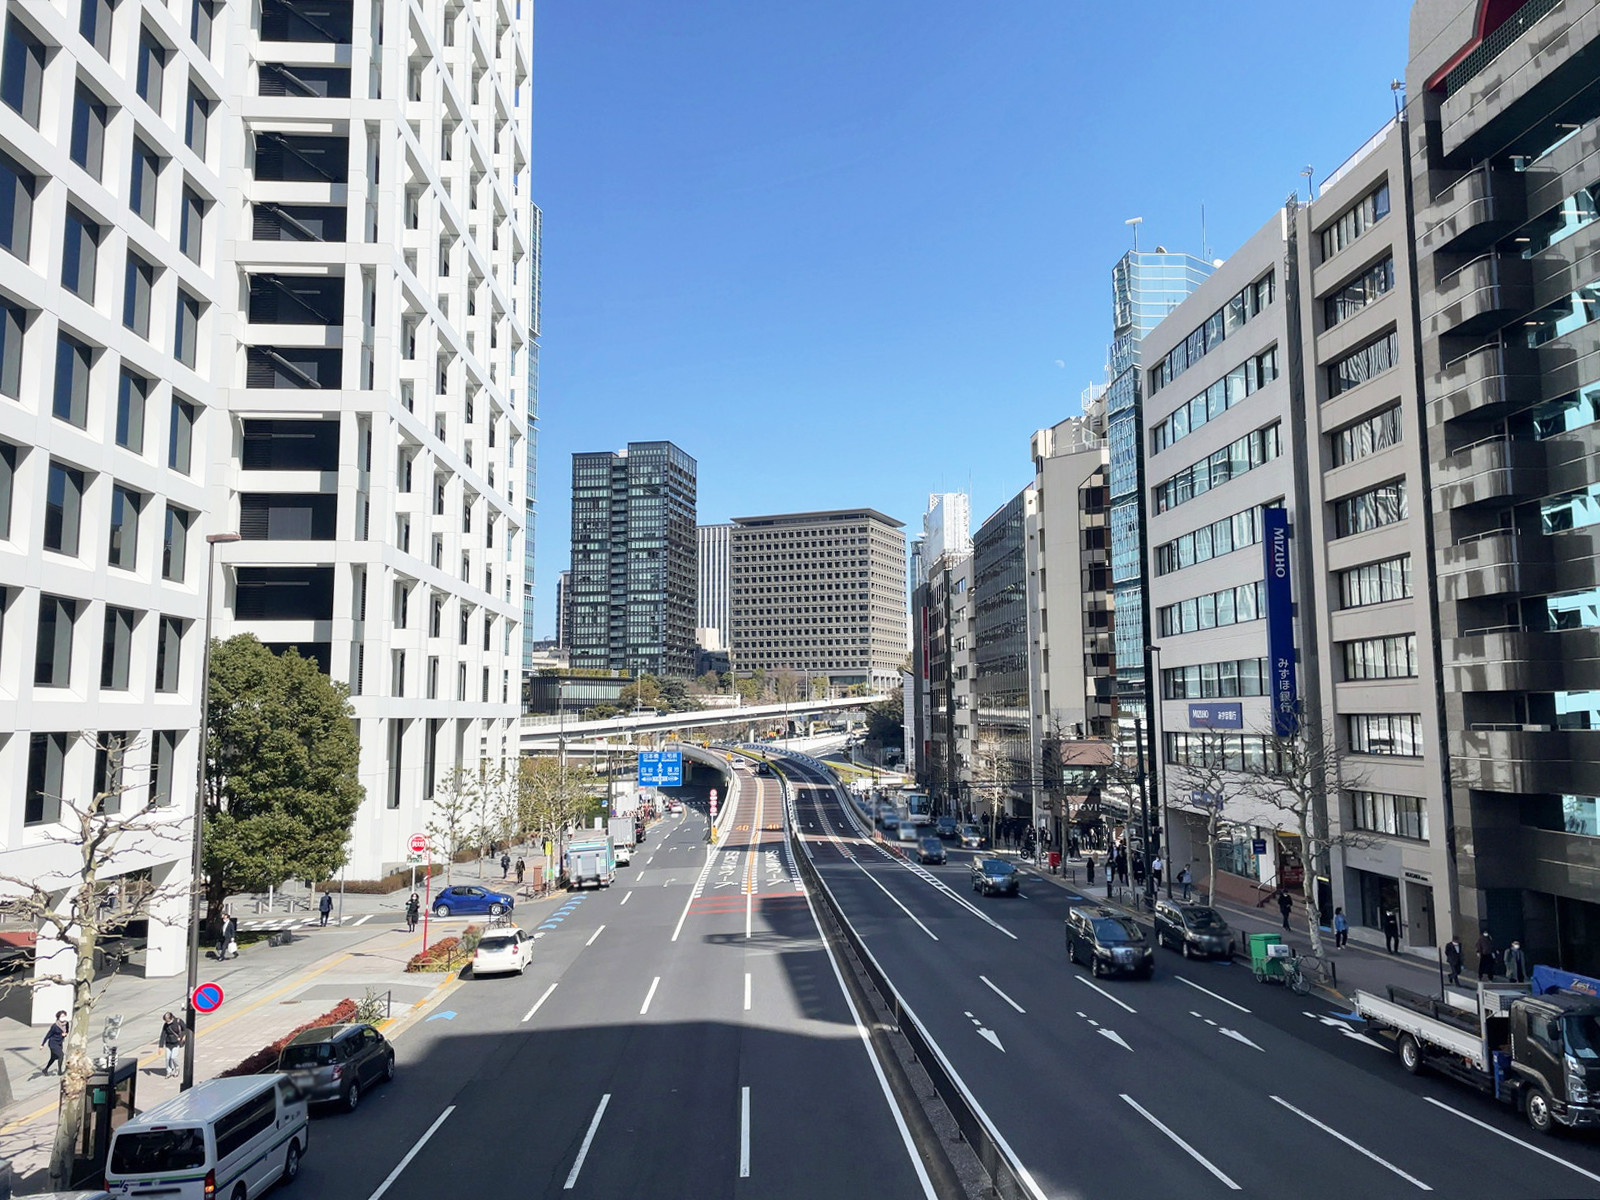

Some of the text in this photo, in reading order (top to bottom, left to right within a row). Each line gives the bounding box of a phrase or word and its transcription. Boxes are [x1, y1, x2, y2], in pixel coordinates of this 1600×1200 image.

[1273, 527, 1286, 578] MIZUHO
[1278, 658, 1290, 713] みずほ銀行
